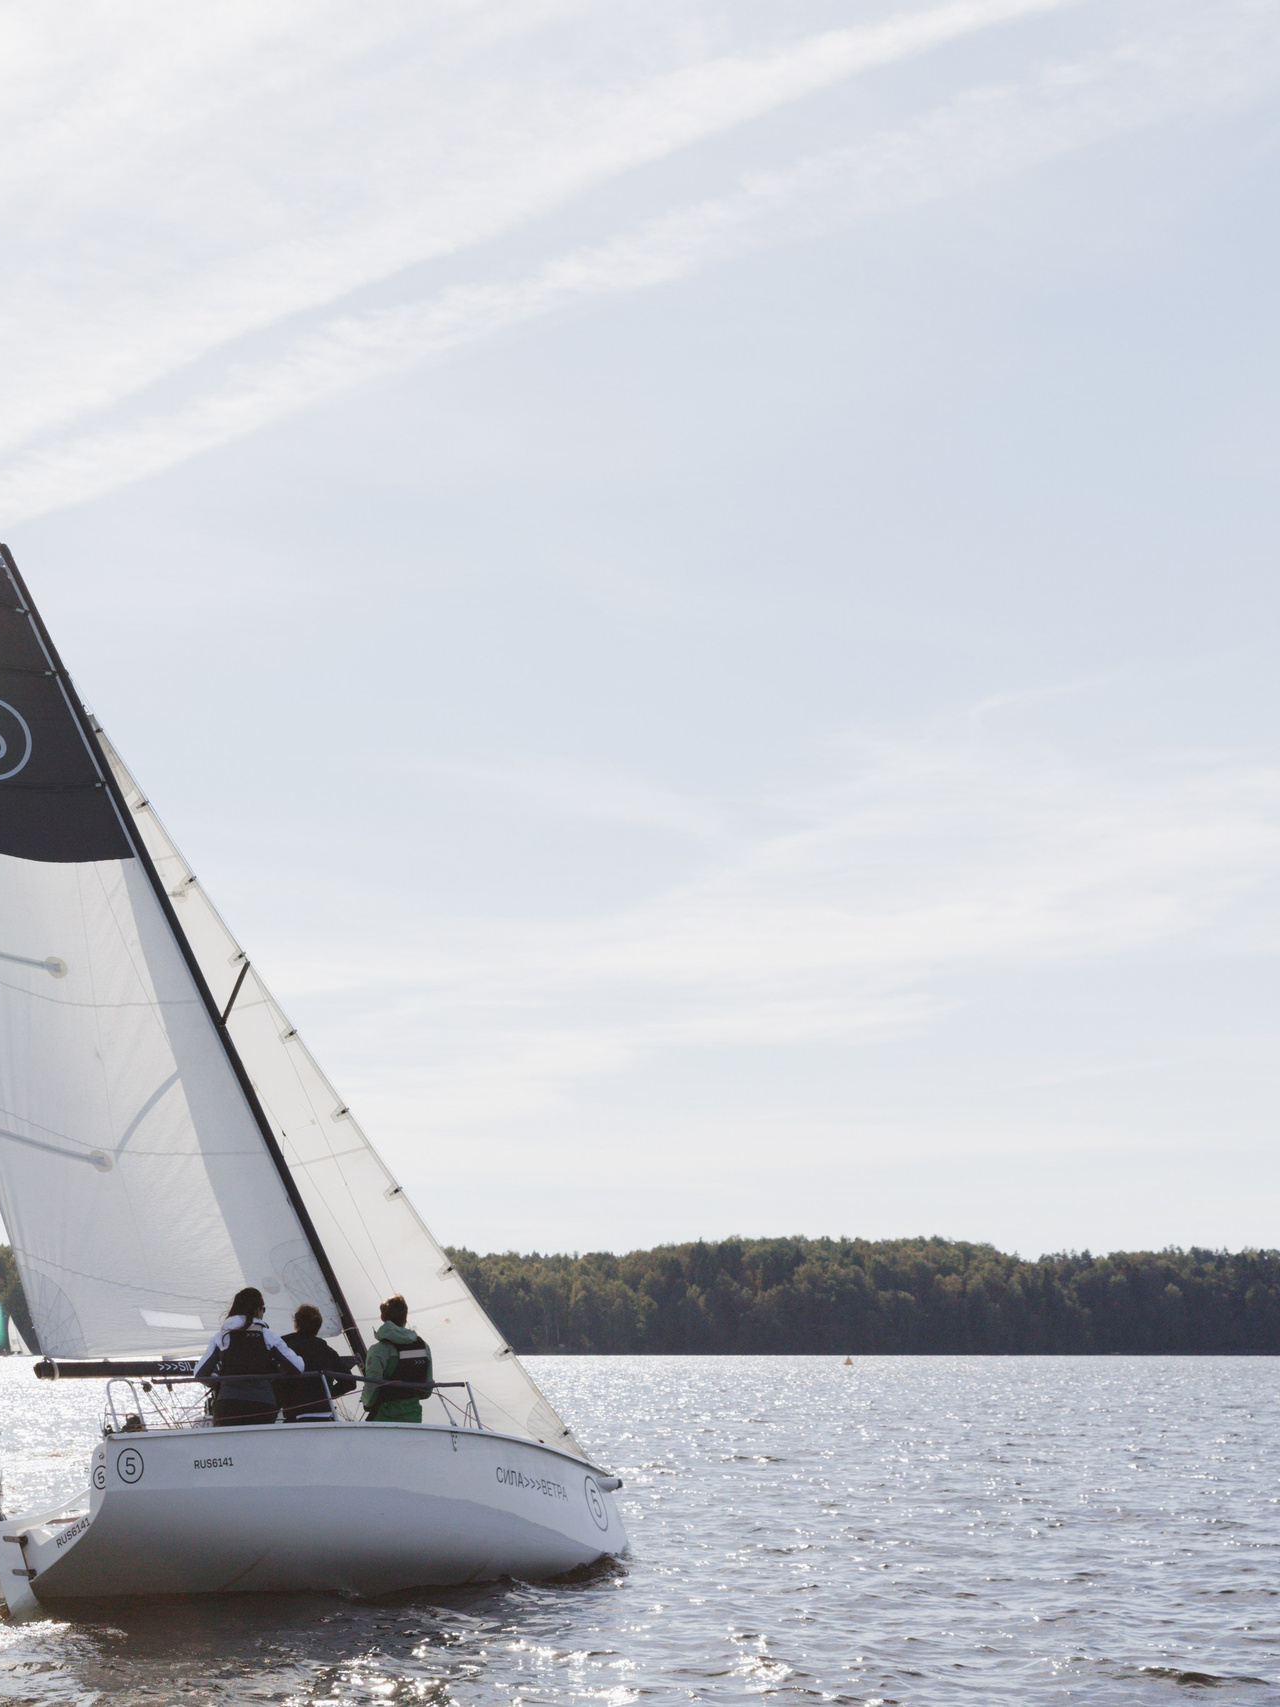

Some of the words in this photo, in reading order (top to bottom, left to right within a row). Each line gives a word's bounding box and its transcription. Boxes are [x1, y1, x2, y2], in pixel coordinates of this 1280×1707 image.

[125, 1457, 136, 1476] 5
[193, 1457, 234, 1470] RUS6141
[97, 1471, 106, 1484] 5
[590, 1489, 602, 1518] 5
[56, 1517, 91, 1549] RUS6141
